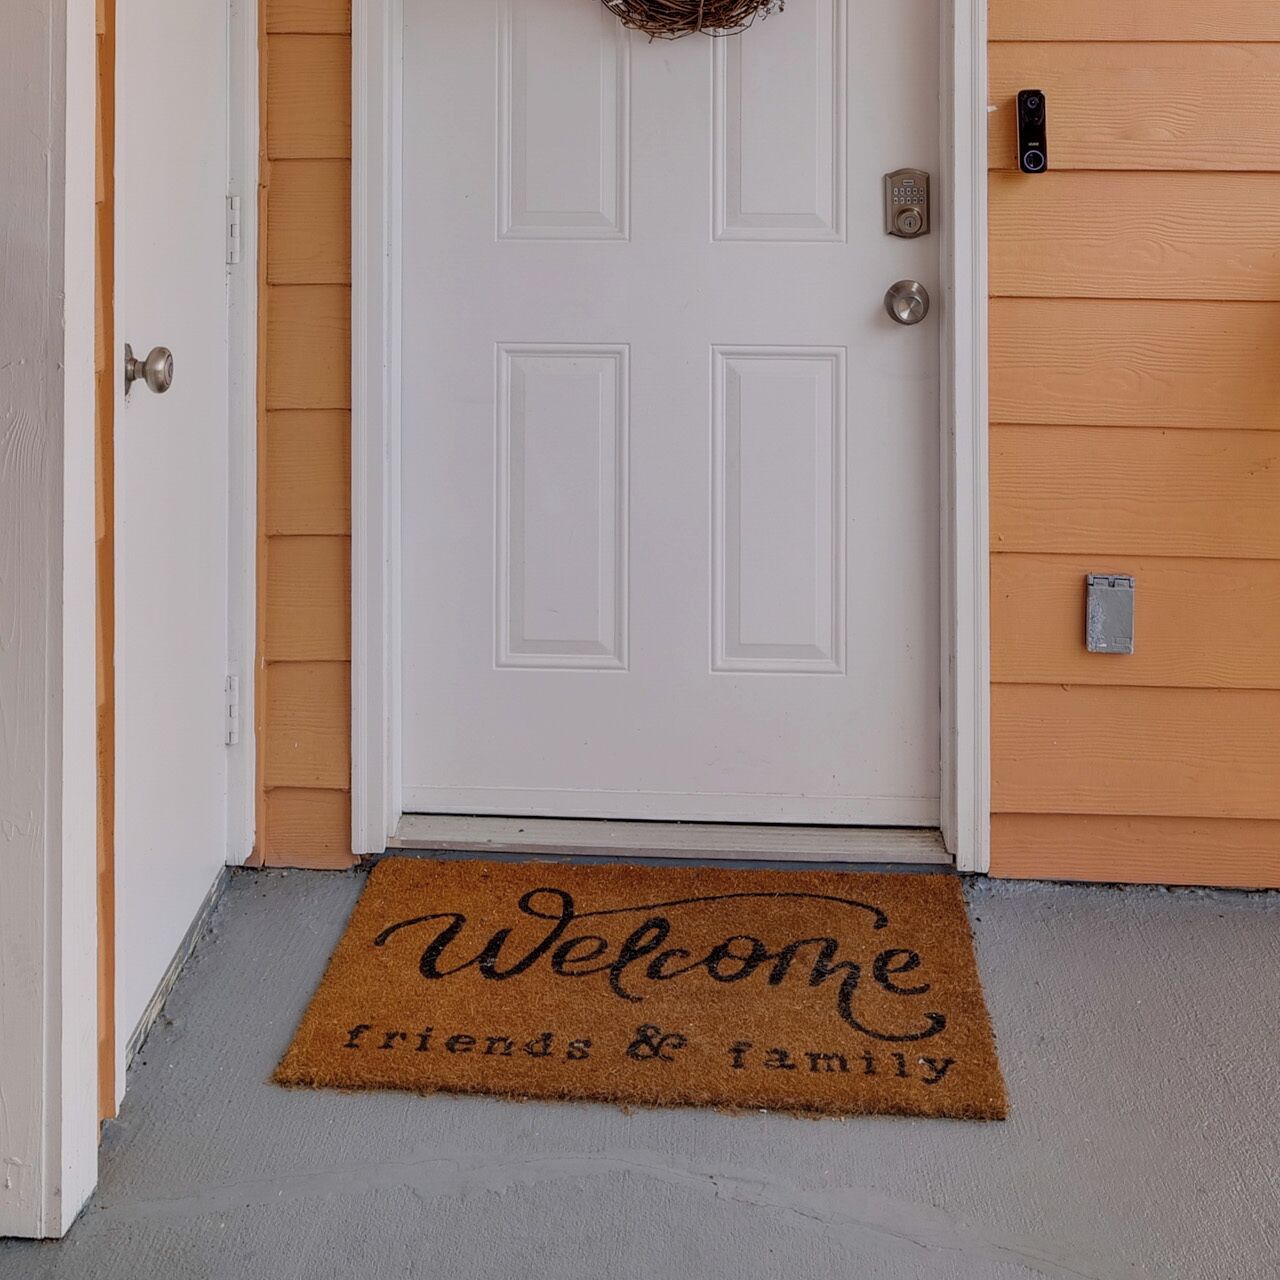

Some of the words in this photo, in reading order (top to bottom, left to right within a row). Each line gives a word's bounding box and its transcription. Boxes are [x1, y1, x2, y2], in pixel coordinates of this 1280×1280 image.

[374, 886, 947, 1042] Welcome
[342, 1022, 593, 1061] friends
[625, 1022, 689, 1062] &
[726, 1039, 957, 1085] family
